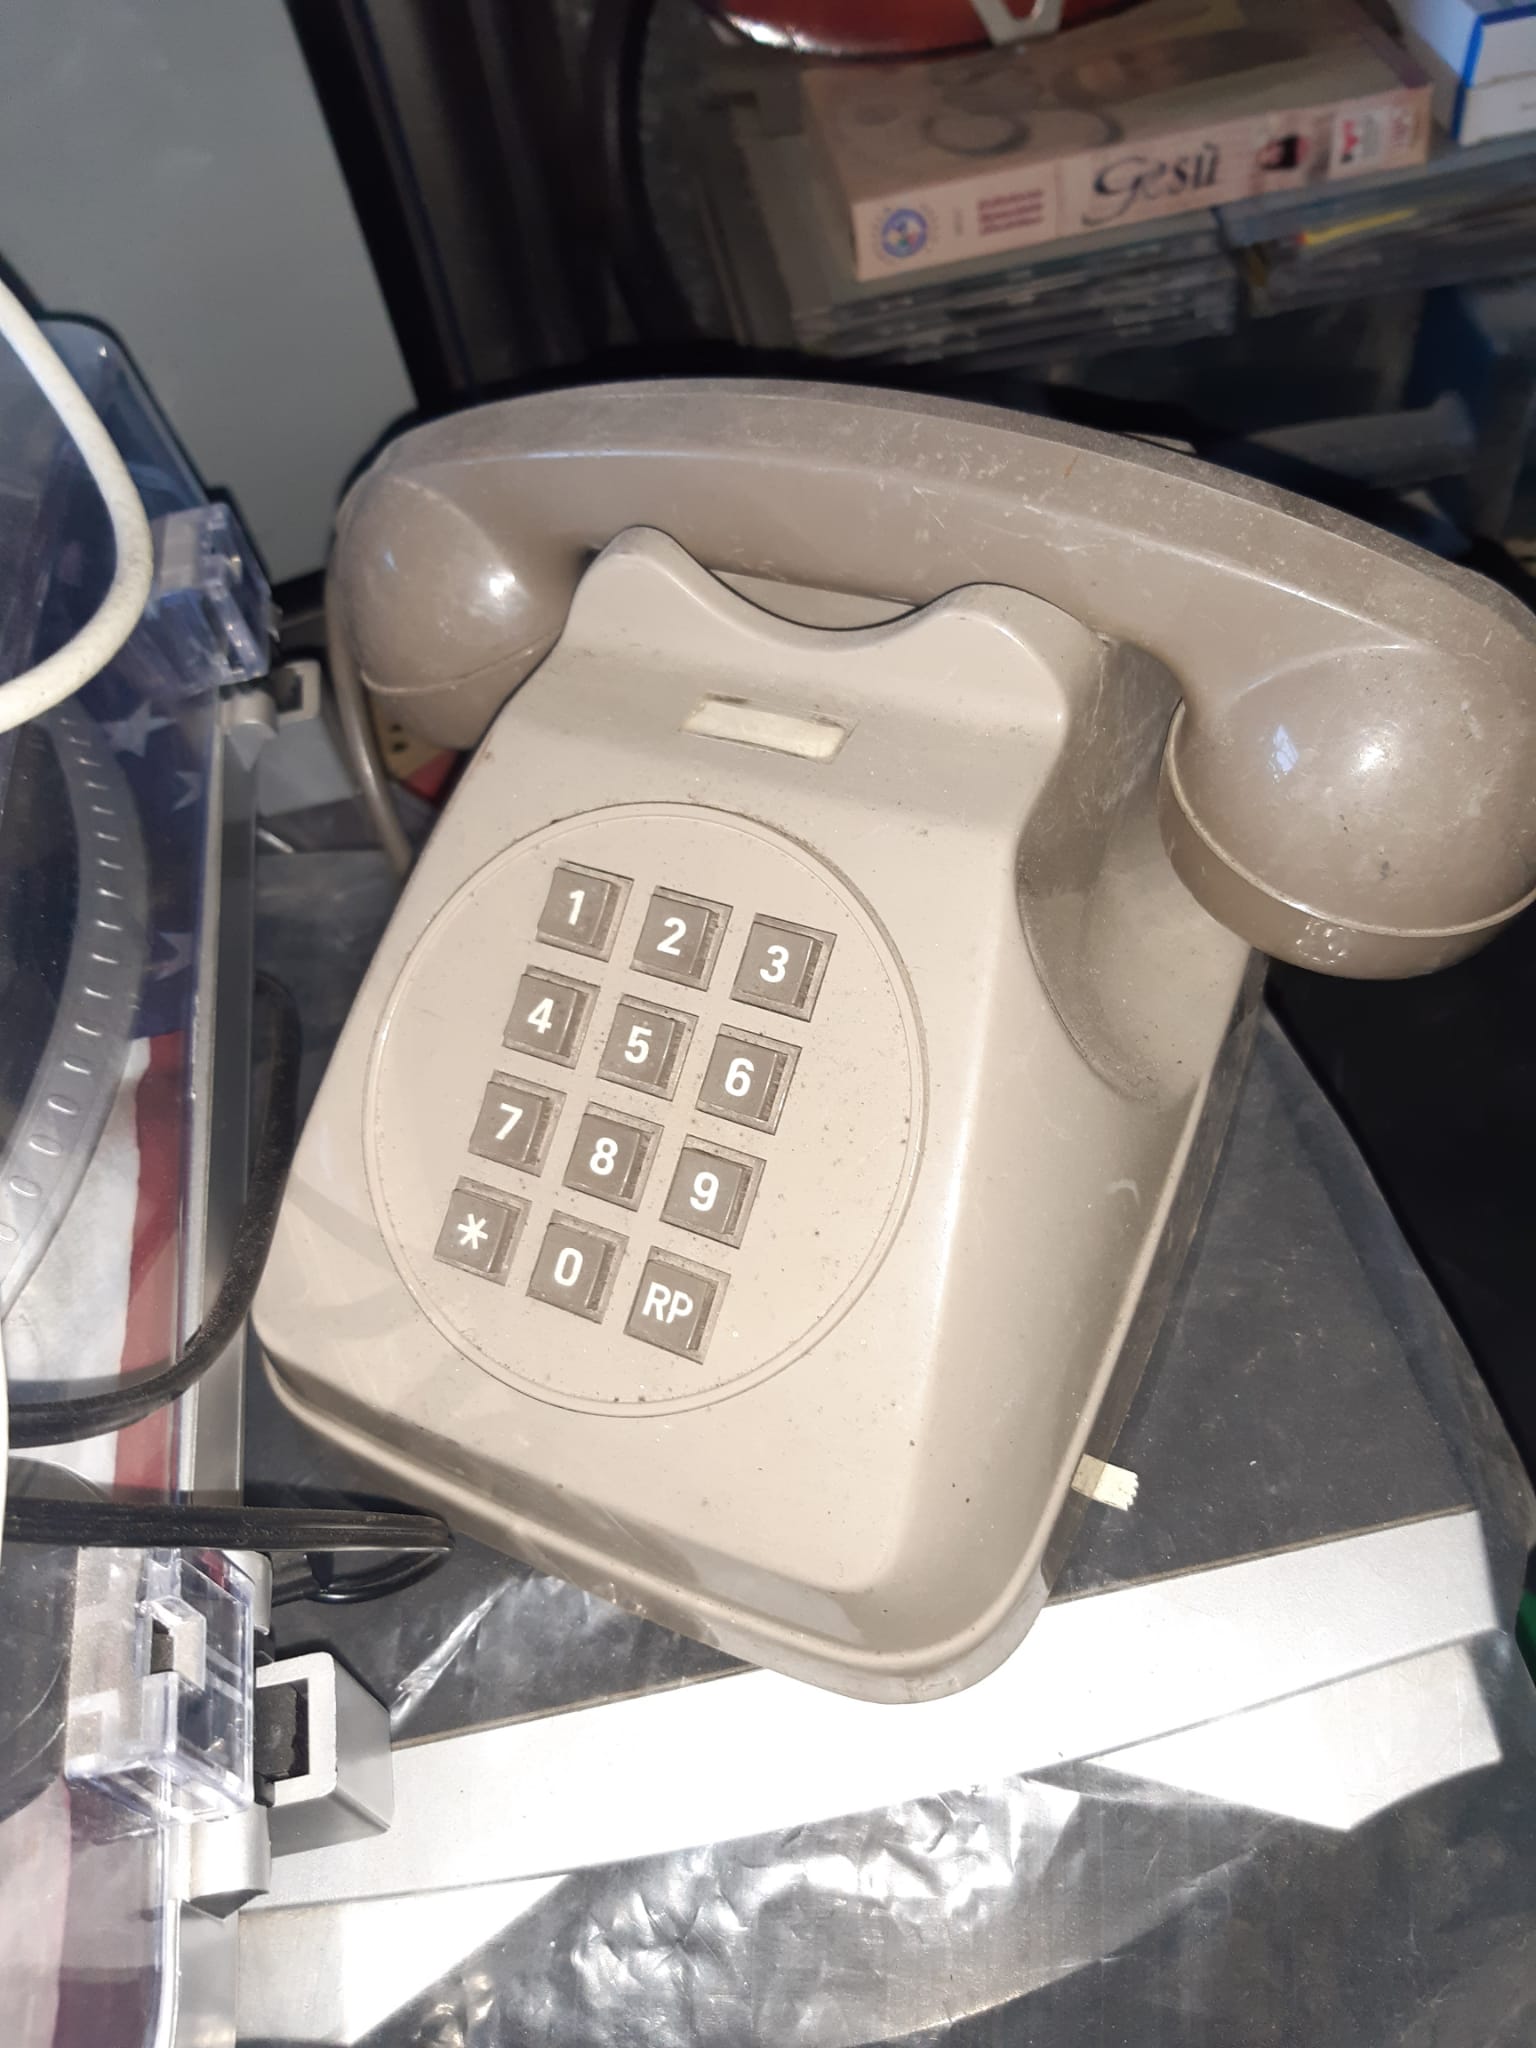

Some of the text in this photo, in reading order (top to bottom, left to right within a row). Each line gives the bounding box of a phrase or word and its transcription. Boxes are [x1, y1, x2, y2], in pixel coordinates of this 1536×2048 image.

[567, 889, 790, 983] 1 2 3
[526, 997, 755, 1097] 4 5 6
[496, 1103, 720, 1212] 7 8 9
[553, 1247, 584, 1287] 0
[641, 1283, 694, 1324] RP
